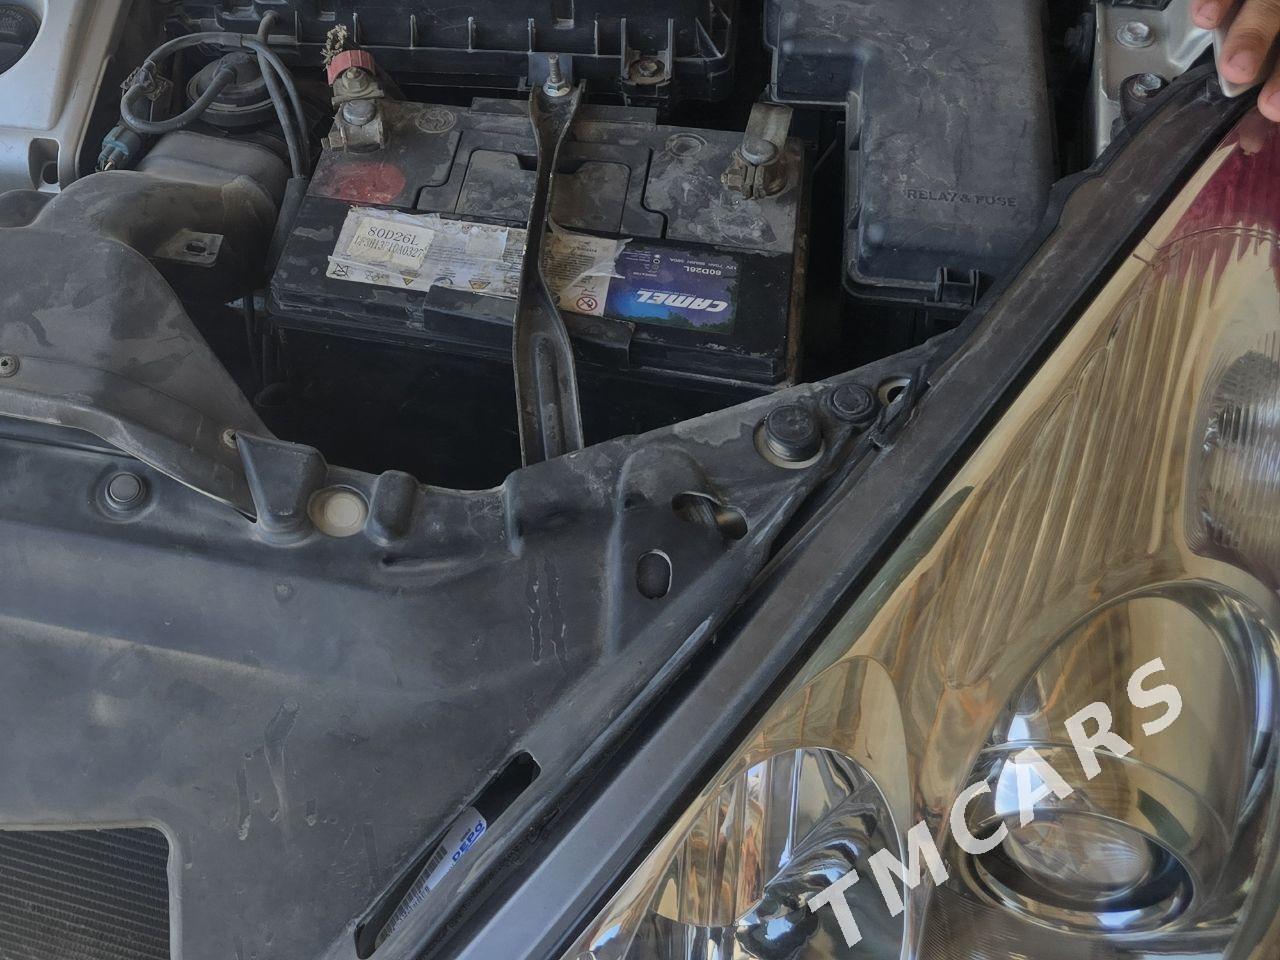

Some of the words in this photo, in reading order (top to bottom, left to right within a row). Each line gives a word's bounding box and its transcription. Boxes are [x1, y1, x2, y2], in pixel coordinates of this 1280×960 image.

[975, 194, 1018, 208] FUSE
[367, 226, 419, 246] 80D26L
[636, 290, 729, 313] CAMEL
[452, 822, 485, 862] DEPO
